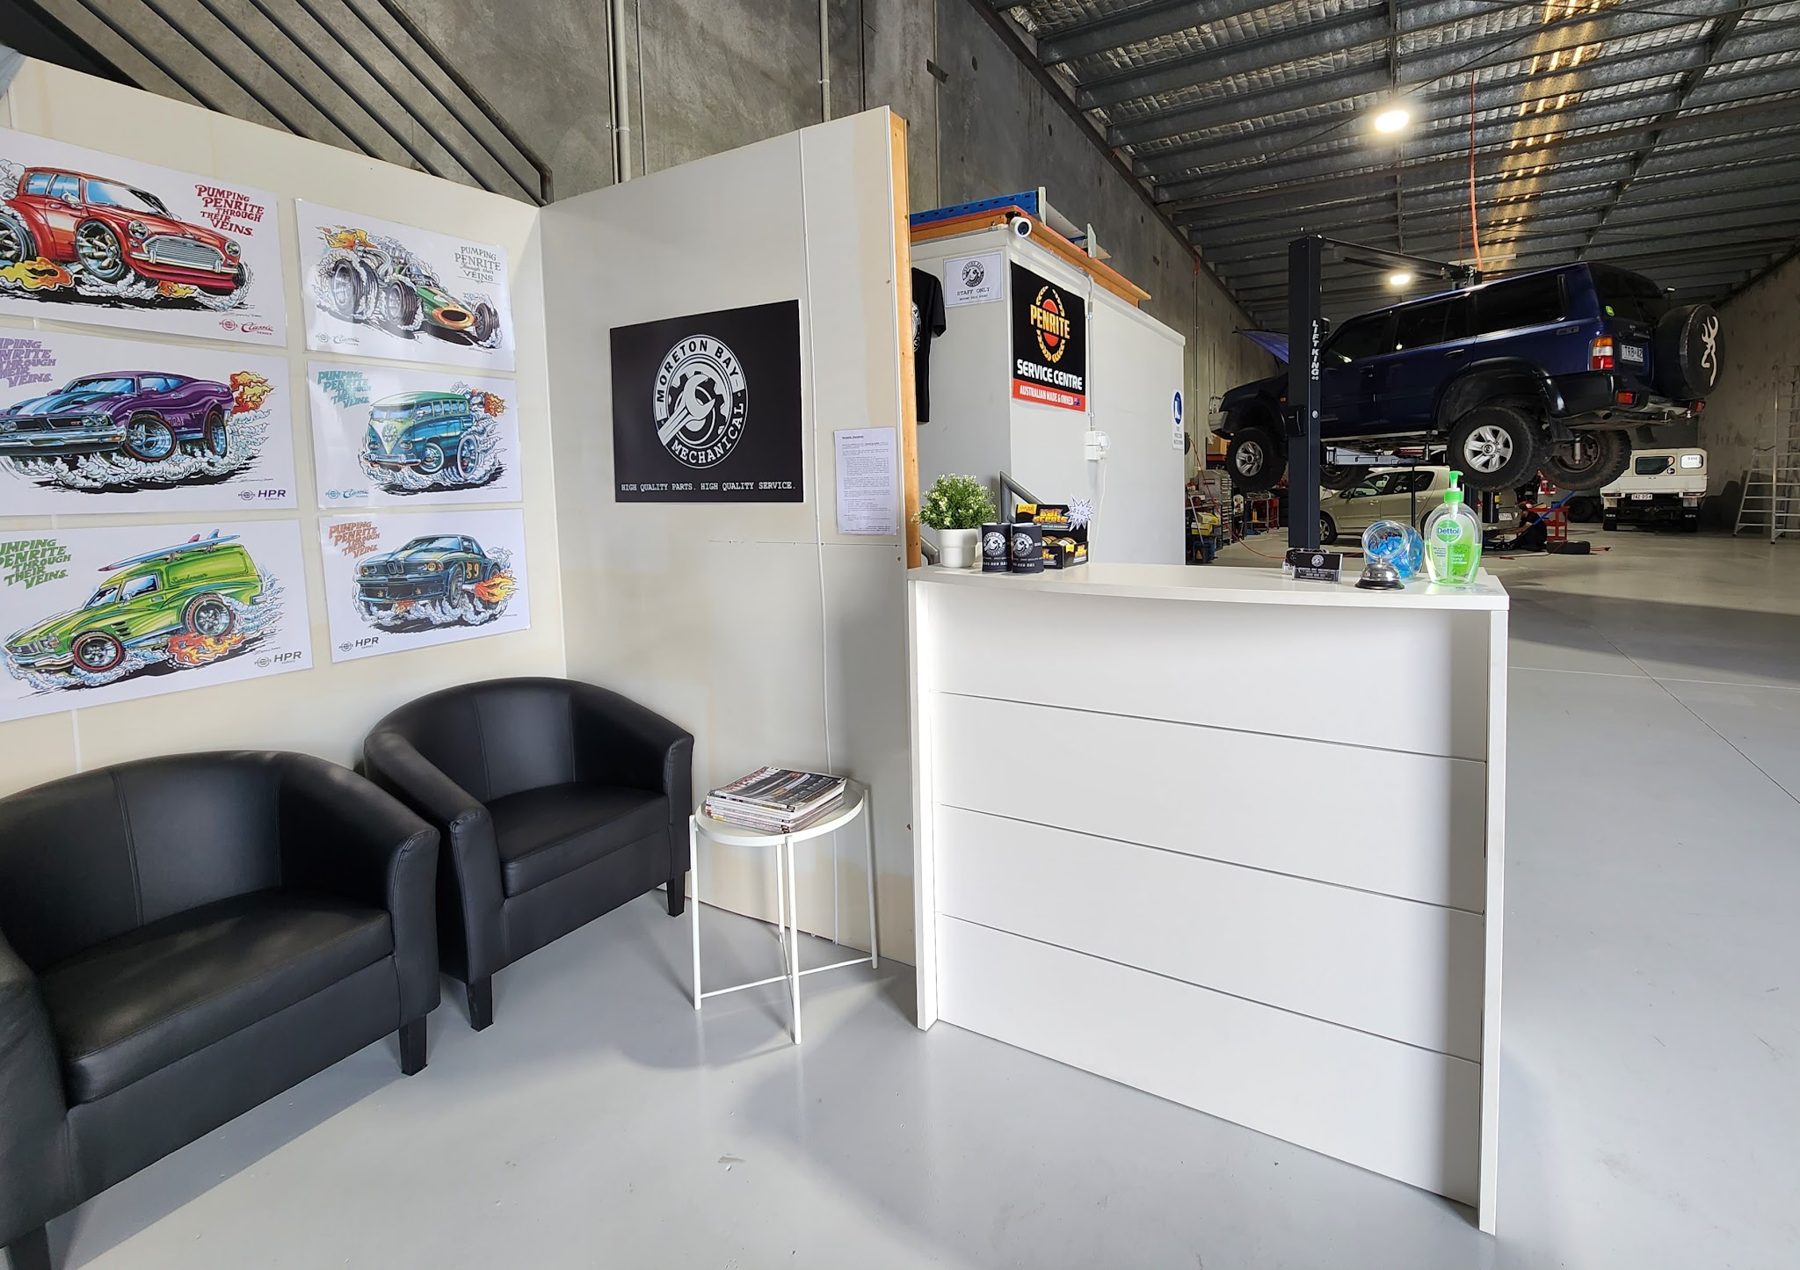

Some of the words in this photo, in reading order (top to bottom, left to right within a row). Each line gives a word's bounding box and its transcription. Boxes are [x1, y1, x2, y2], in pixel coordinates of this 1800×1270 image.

[195, 184, 250, 202] PUMPING
[202, 196, 264, 215] PENRITE
[200, 211, 231, 222] THEIR
[216, 207, 262, 223] THROUGH
[455, 252, 501, 271] PENRITE
[460, 246, 497, 261] PUMPING
[463, 269, 494, 281] VEINS
[1030, 304, 1071, 340] PENRITE
[1312, 319, 1320, 347] LIFT
[1311, 348, 1320, 375] KING
[656, 340, 708, 403] MORETON
[715, 345, 739, 377] BAY
[1017, 358, 1053, 383] SERVICE
[1053, 369, 1083, 391] CENTRE
[671, 402, 744, 464] MECHANICAL
[258, 489, 287, 498] HPR
[621, 484, 637, 492] HIGH
[640, 483, 669, 492] QUALITY
[700, 482, 718, 490] HIGH
[722, 482, 754, 491] QUALITY
[328, 521, 372, 539] PUMPING
[334, 526, 378, 546] PENRITE
[1436, 527, 1460, 535] Dettol
[11, 554, 72, 572] THROUGH
[3, 566, 46, 587] THEIR
[354, 636, 379, 648] HPR
[273, 651, 302, 663] HPR
